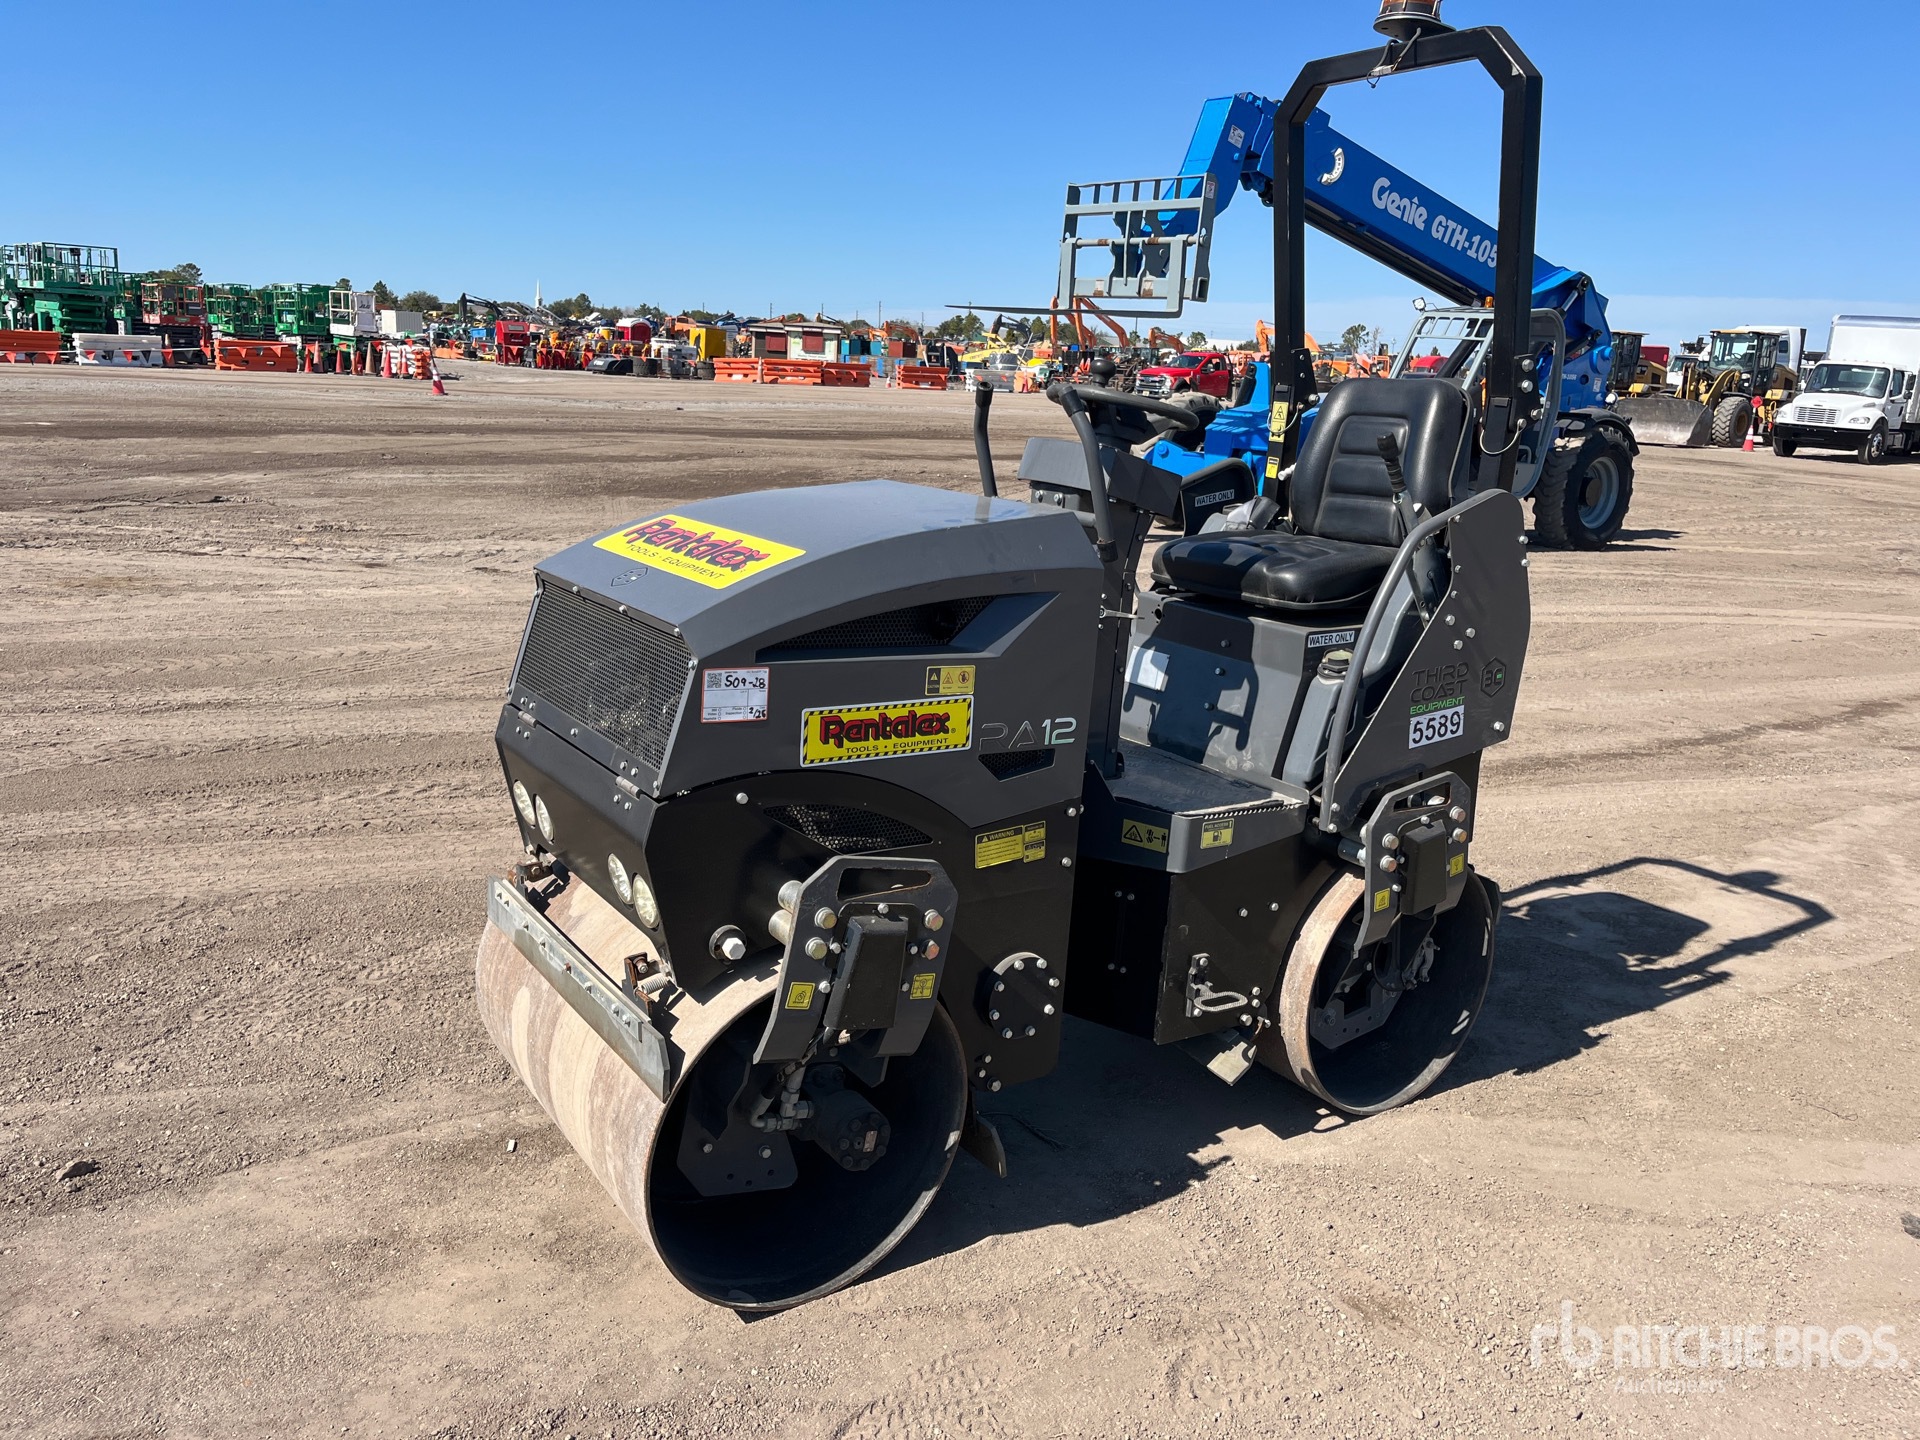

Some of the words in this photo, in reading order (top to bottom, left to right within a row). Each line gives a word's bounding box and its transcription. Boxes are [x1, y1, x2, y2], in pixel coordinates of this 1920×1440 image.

[1372, 177, 1428, 231] Genie
[1196, 494, 1217, 505] WATER
[1218, 491, 1234, 501] ONLY
[622, 518, 771, 572] Rentalex
[626, 543, 659, 558] TOOLS
[662, 556, 725, 580] EQUIPMENT
[1310, 635, 1333, 646] WATER
[1335, 632, 1353, 643] ONLY
[1411, 662, 1469, 686] THIRD
[1410, 679, 1468, 703] COAST
[1410, 696, 1465, 715] EQUIPMENT
[819, 710, 950, 749] Rentalex
[1411, 711, 1461, 745] 5589
[845, 745, 879, 754] TOOLS
[893, 737, 949, 749] EQUIPMENT
[989, 830, 1015, 841] WARNING
